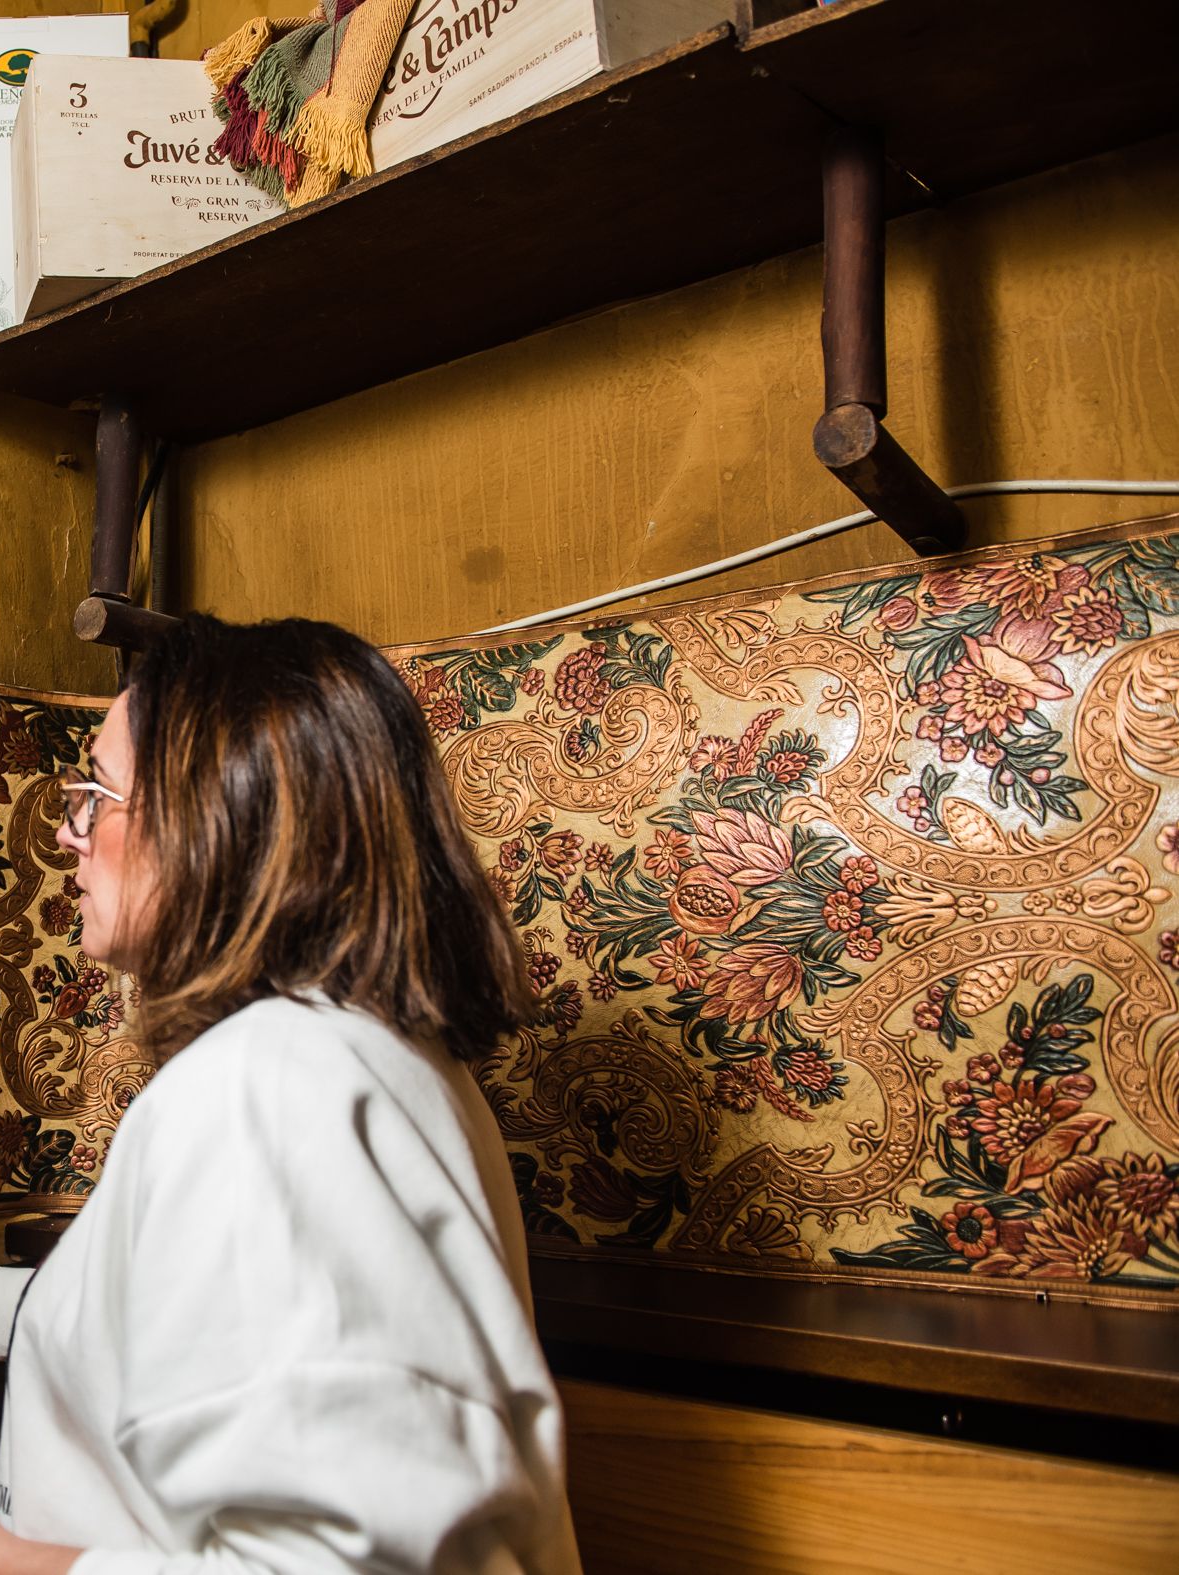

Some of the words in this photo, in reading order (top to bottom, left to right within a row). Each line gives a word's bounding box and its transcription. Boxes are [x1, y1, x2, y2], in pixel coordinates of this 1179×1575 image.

[401, 52, 422, 84] &
[404, 90, 420, 107] DE
[422, 80, 436, 96] LA
[438, 46, 486, 84] FAMILIA
[468, 93, 486, 107] SANT
[554, 29, 583, 54] ESPAÑA
[69, 82, 88, 109] 3
[60, 111, 99, 119] BOTELLAS
[170, 108, 207, 124] BRUT
[123, 129, 201, 169] Juvé
[204, 143, 225, 166] &
[150, 174, 202, 187] RESERVA
[206, 176, 221, 186] DE
[226, 177, 240, 187] LA
[206, 196, 240, 209] GRAN
[198, 211, 250, 225] RESERVA
